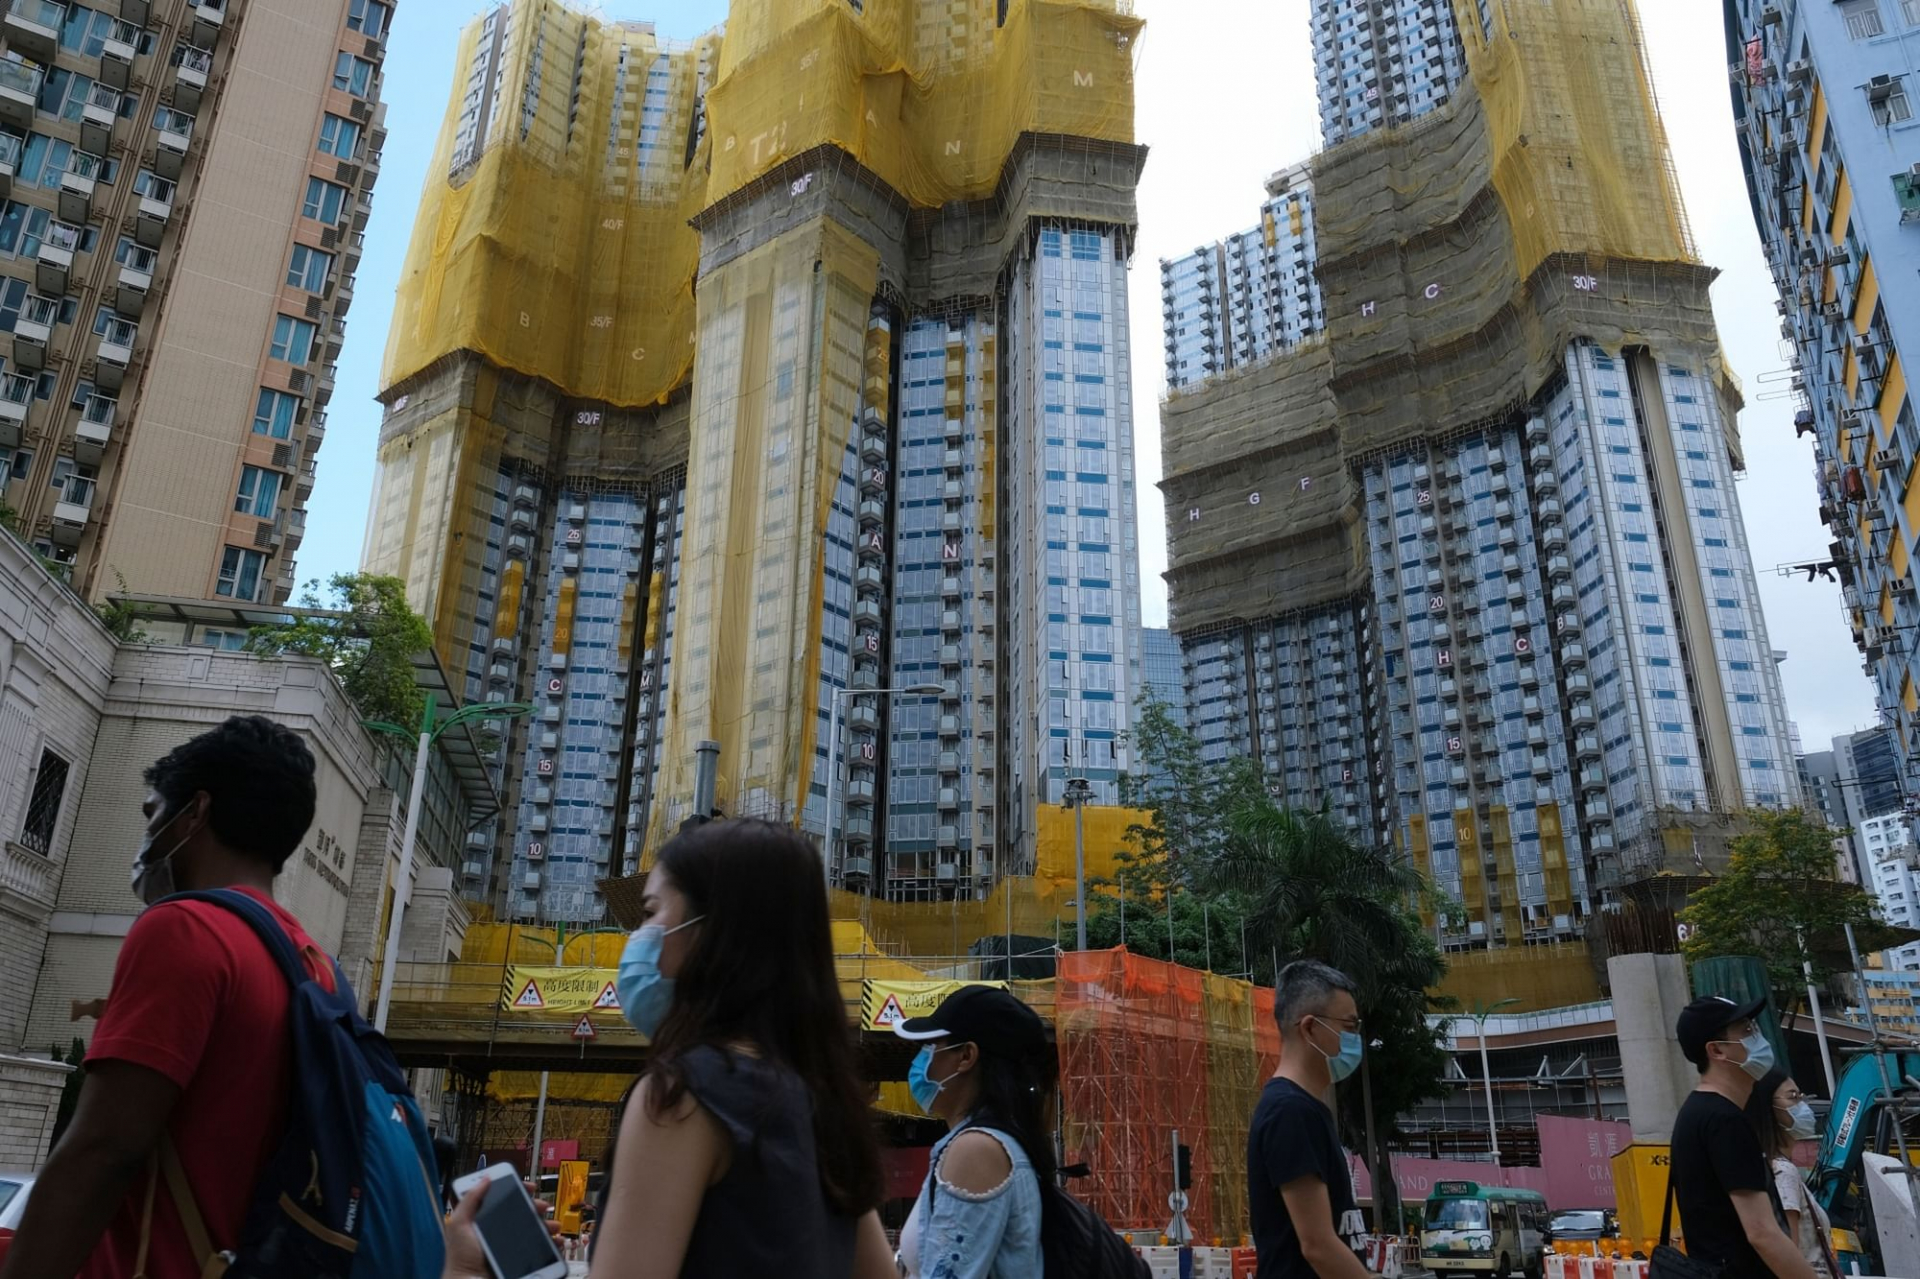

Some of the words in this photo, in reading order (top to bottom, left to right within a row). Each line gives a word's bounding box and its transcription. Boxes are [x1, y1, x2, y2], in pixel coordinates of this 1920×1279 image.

[1073, 69, 1093, 87] M
[1366, 87, 1378, 98] 45
[866, 108, 877, 128] A
[725, 136, 735, 152] B
[945, 140, 960, 155] N
[791, 173, 812, 197] 30/F
[602, 218, 624, 230] 40/F
[1573, 275, 1597, 291] 30/F
[1425, 283, 1439, 299] C
[1361, 301, 1374, 317] H
[519, 311, 531, 328] B
[590, 315, 613, 329] 35/F
[632, 347, 645, 360] C
[577, 411, 600, 425] 30/F
[873, 469, 884, 485] 20
[1300, 477, 1310, 490] F
[1249, 492, 1260, 505] G
[1417, 490, 1430, 504] 25
[1189, 508, 1200, 521] H
[567, 528, 580, 539] 25
[871, 534, 882, 550] A
[943, 543, 957, 558] N
[1430, 595, 1443, 609] 20
[1557, 616, 1564, 631] B
[555, 627, 568, 639] 20
[867, 635, 878, 651] 15
[1516, 638, 1528, 651] C
[1438, 650, 1450, 665] H
[549, 678, 560, 690] C
[1448, 737, 1460, 750] 15
[862, 743, 874, 759] 10
[539, 759, 552, 771] 15
[1343, 769, 1351, 781] F
[1459, 827, 1471, 841] 10
[529, 842, 541, 855] 10
[543, 979, 599, 993] 高度限制
[905, 992, 949, 1008] 高度
[1588, 1164, 1612, 1180] GRA
